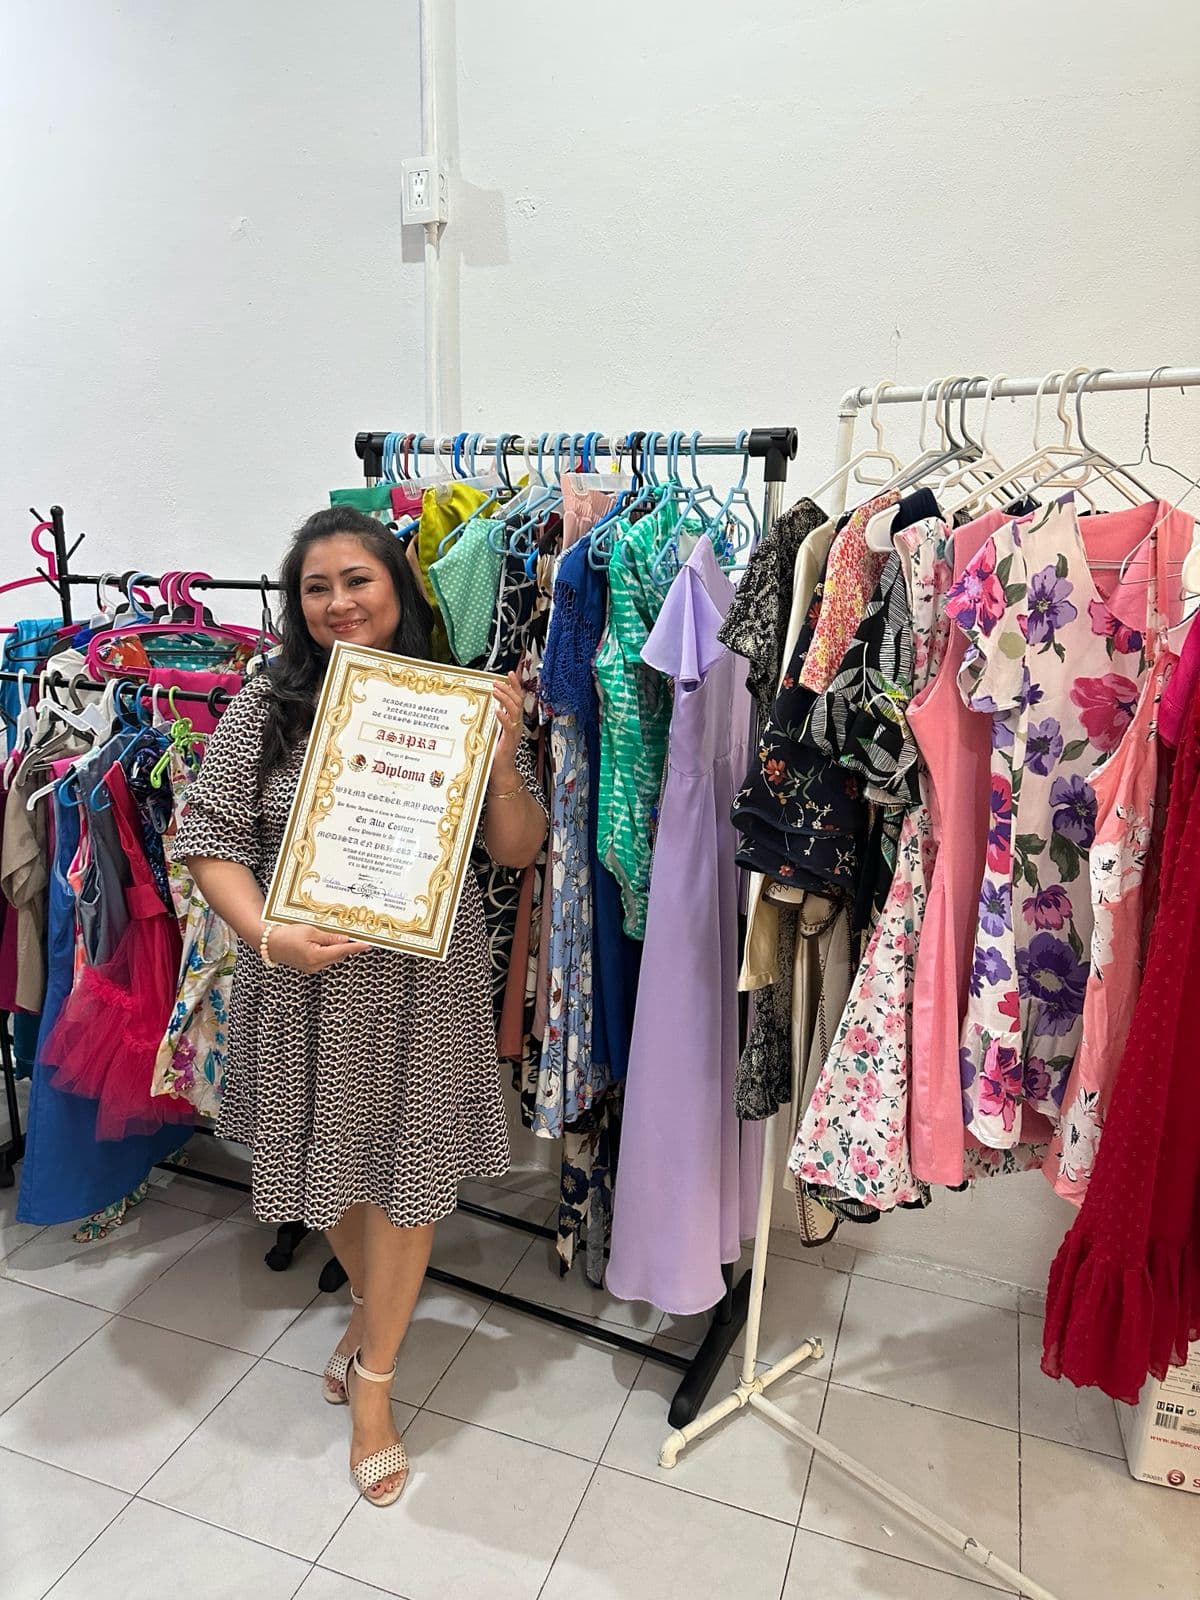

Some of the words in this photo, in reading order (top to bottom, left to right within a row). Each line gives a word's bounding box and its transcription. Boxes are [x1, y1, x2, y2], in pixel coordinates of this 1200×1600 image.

[376, 729, 436, 750] ASIPRA
[372, 760, 426, 782] Diploma
[355, 815, 366, 824] En
[369, 818, 385, 828] Alta
[388, 822, 414, 834] Costura
[316, 830, 358, 844] MODISTA
[374, 842, 411, 856] PRIERA
[414, 850, 439, 862] LASE
